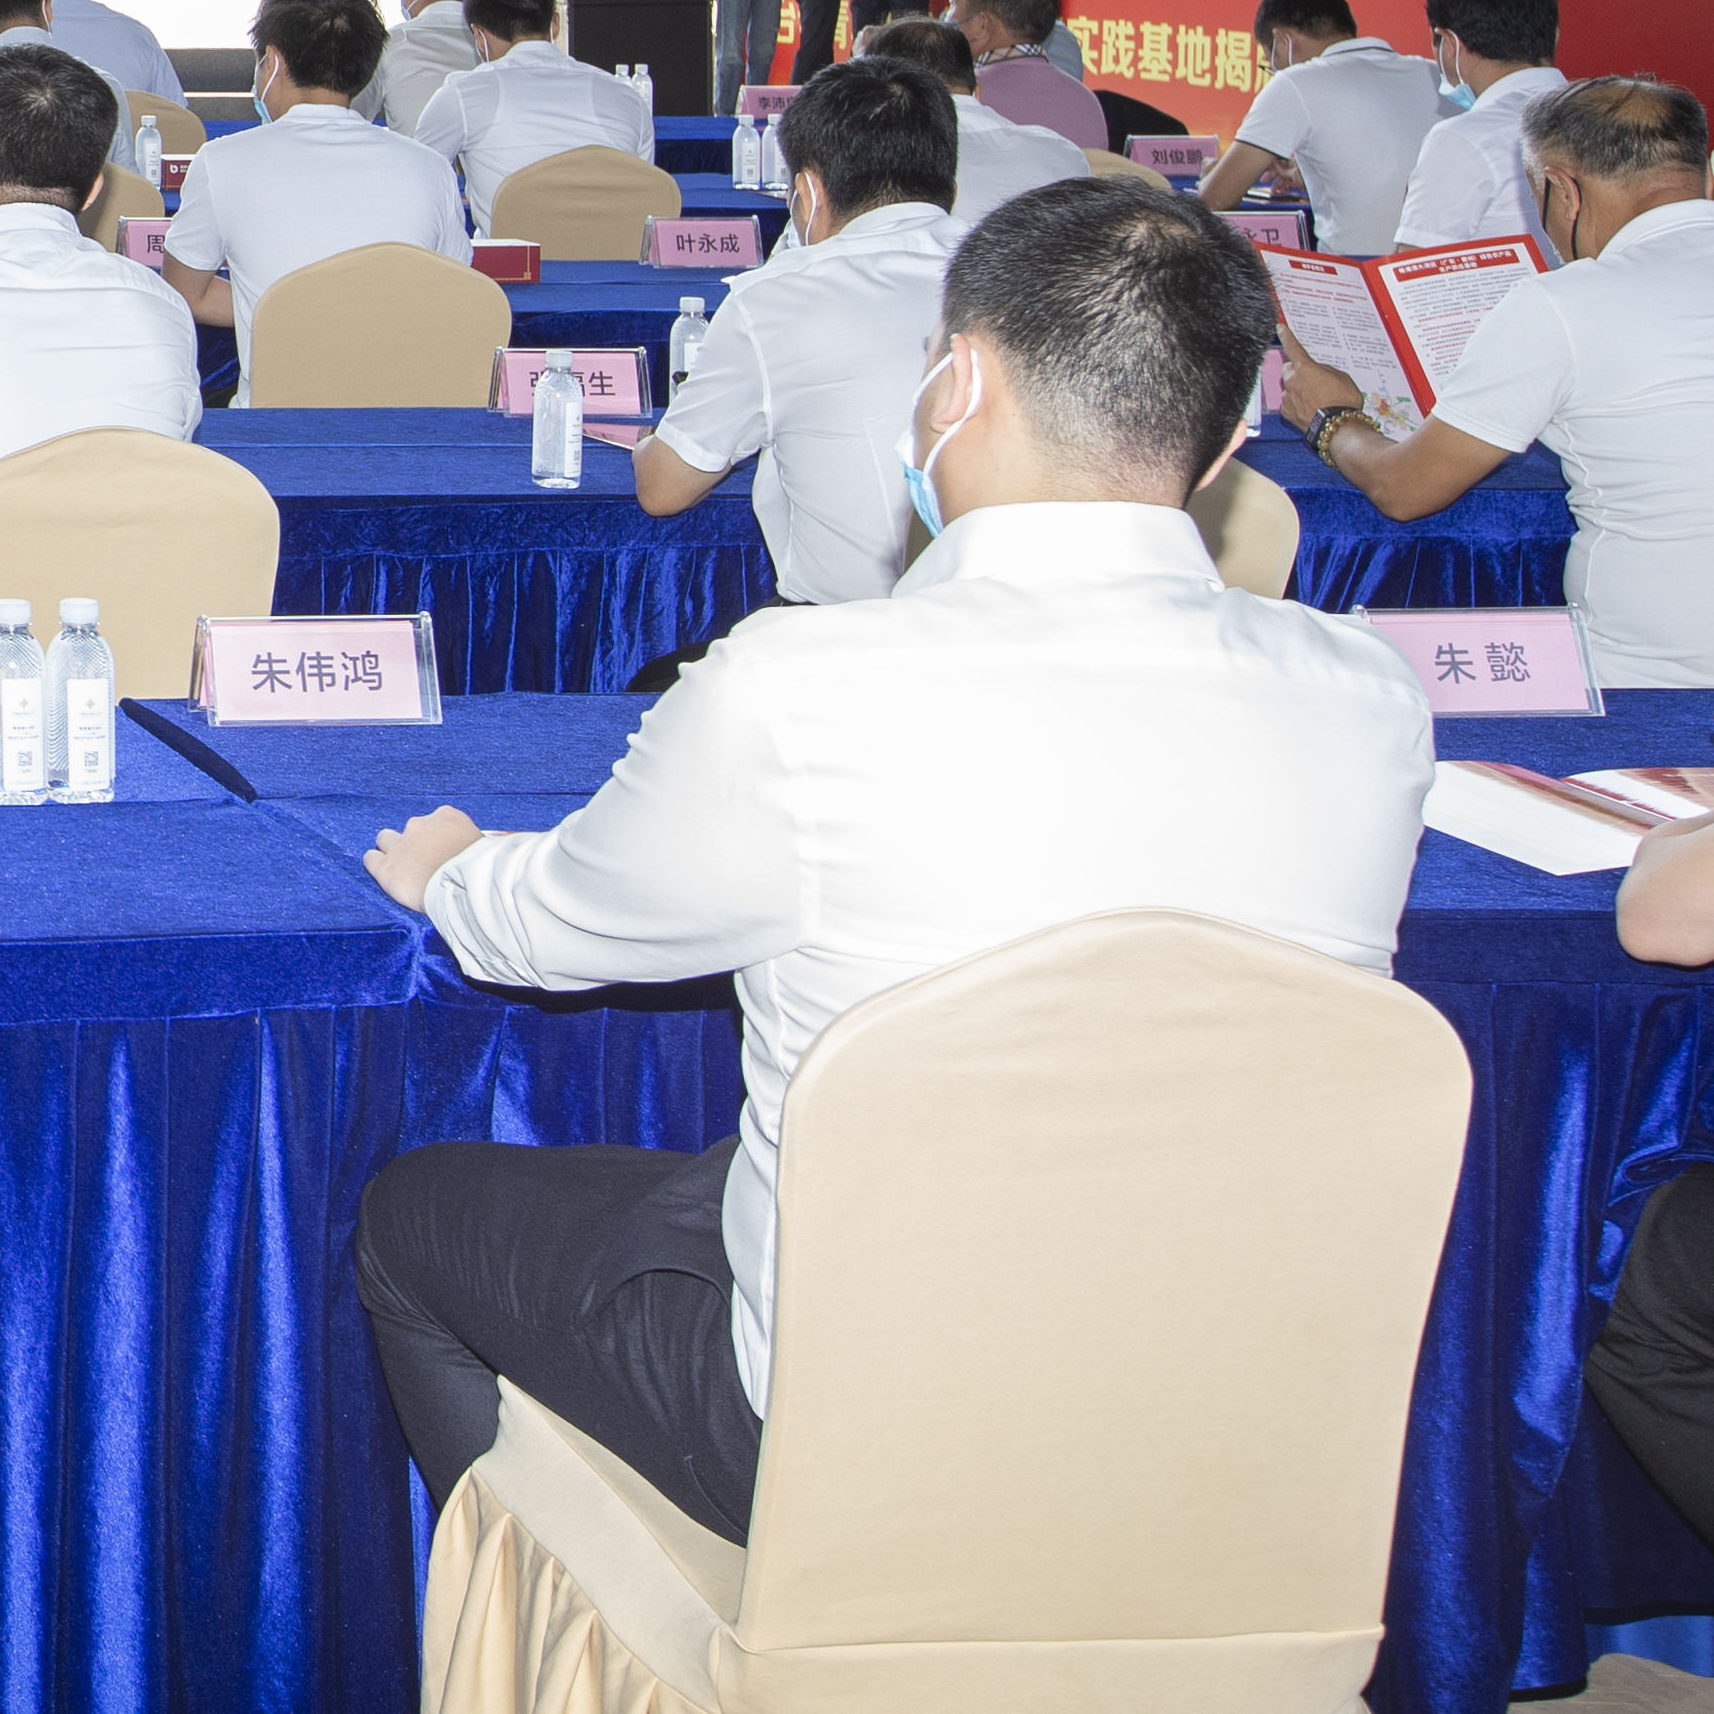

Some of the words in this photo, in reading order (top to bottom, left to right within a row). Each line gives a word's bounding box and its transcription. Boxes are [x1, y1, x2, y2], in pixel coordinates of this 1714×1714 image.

[675, 232, 741, 254] 叶永成
[250, 649, 384, 695] 朱伟鸿
